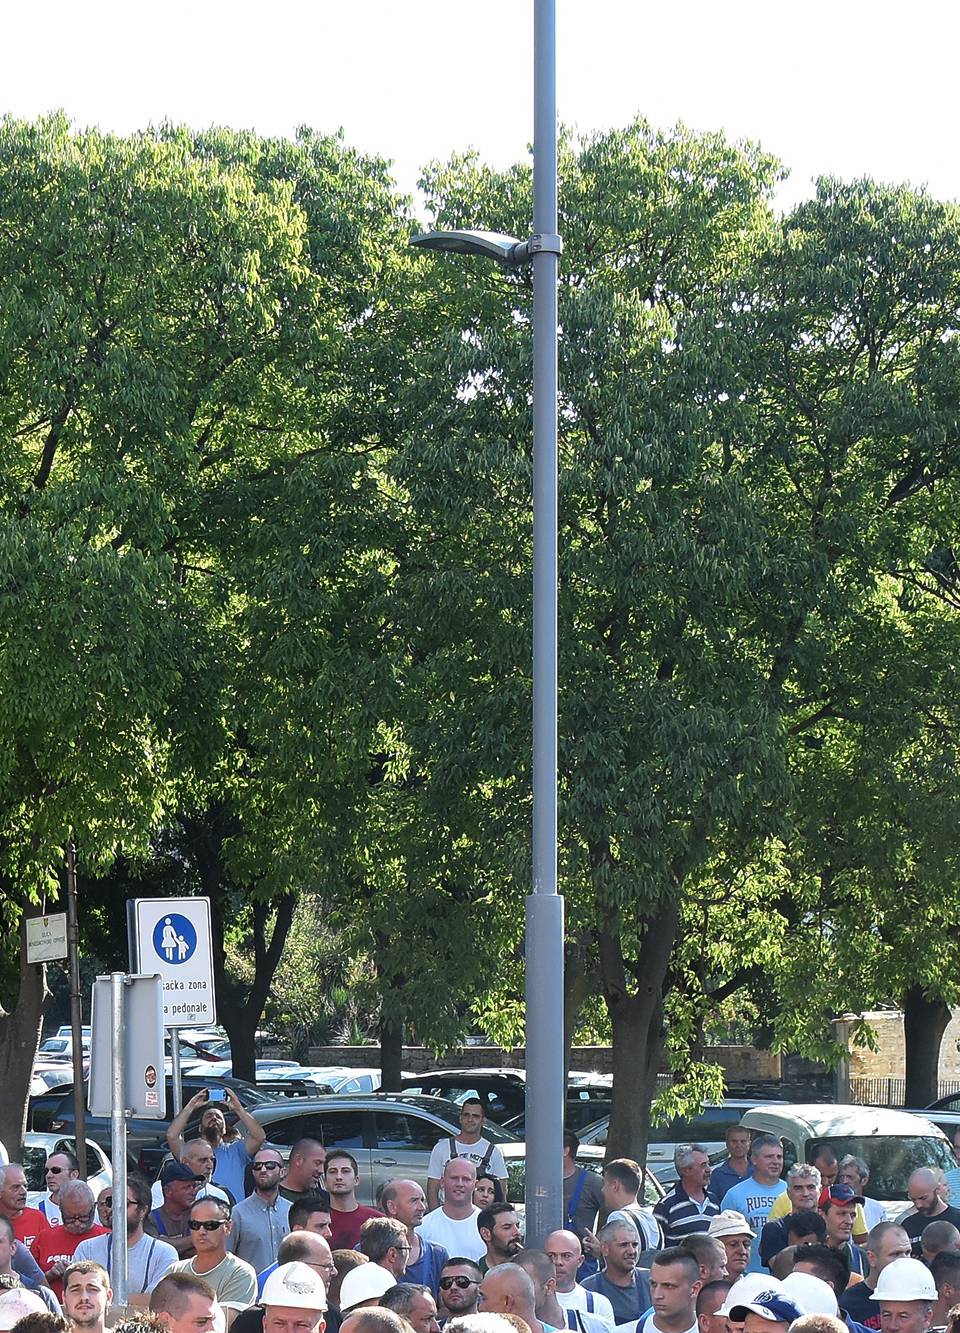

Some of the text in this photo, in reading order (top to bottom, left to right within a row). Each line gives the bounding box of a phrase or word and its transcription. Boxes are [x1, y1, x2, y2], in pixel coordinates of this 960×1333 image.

[188, 981, 207, 990] zona
[172, 1002, 208, 1016] pedonale
[746, 1196, 777, 1214] RUSS
